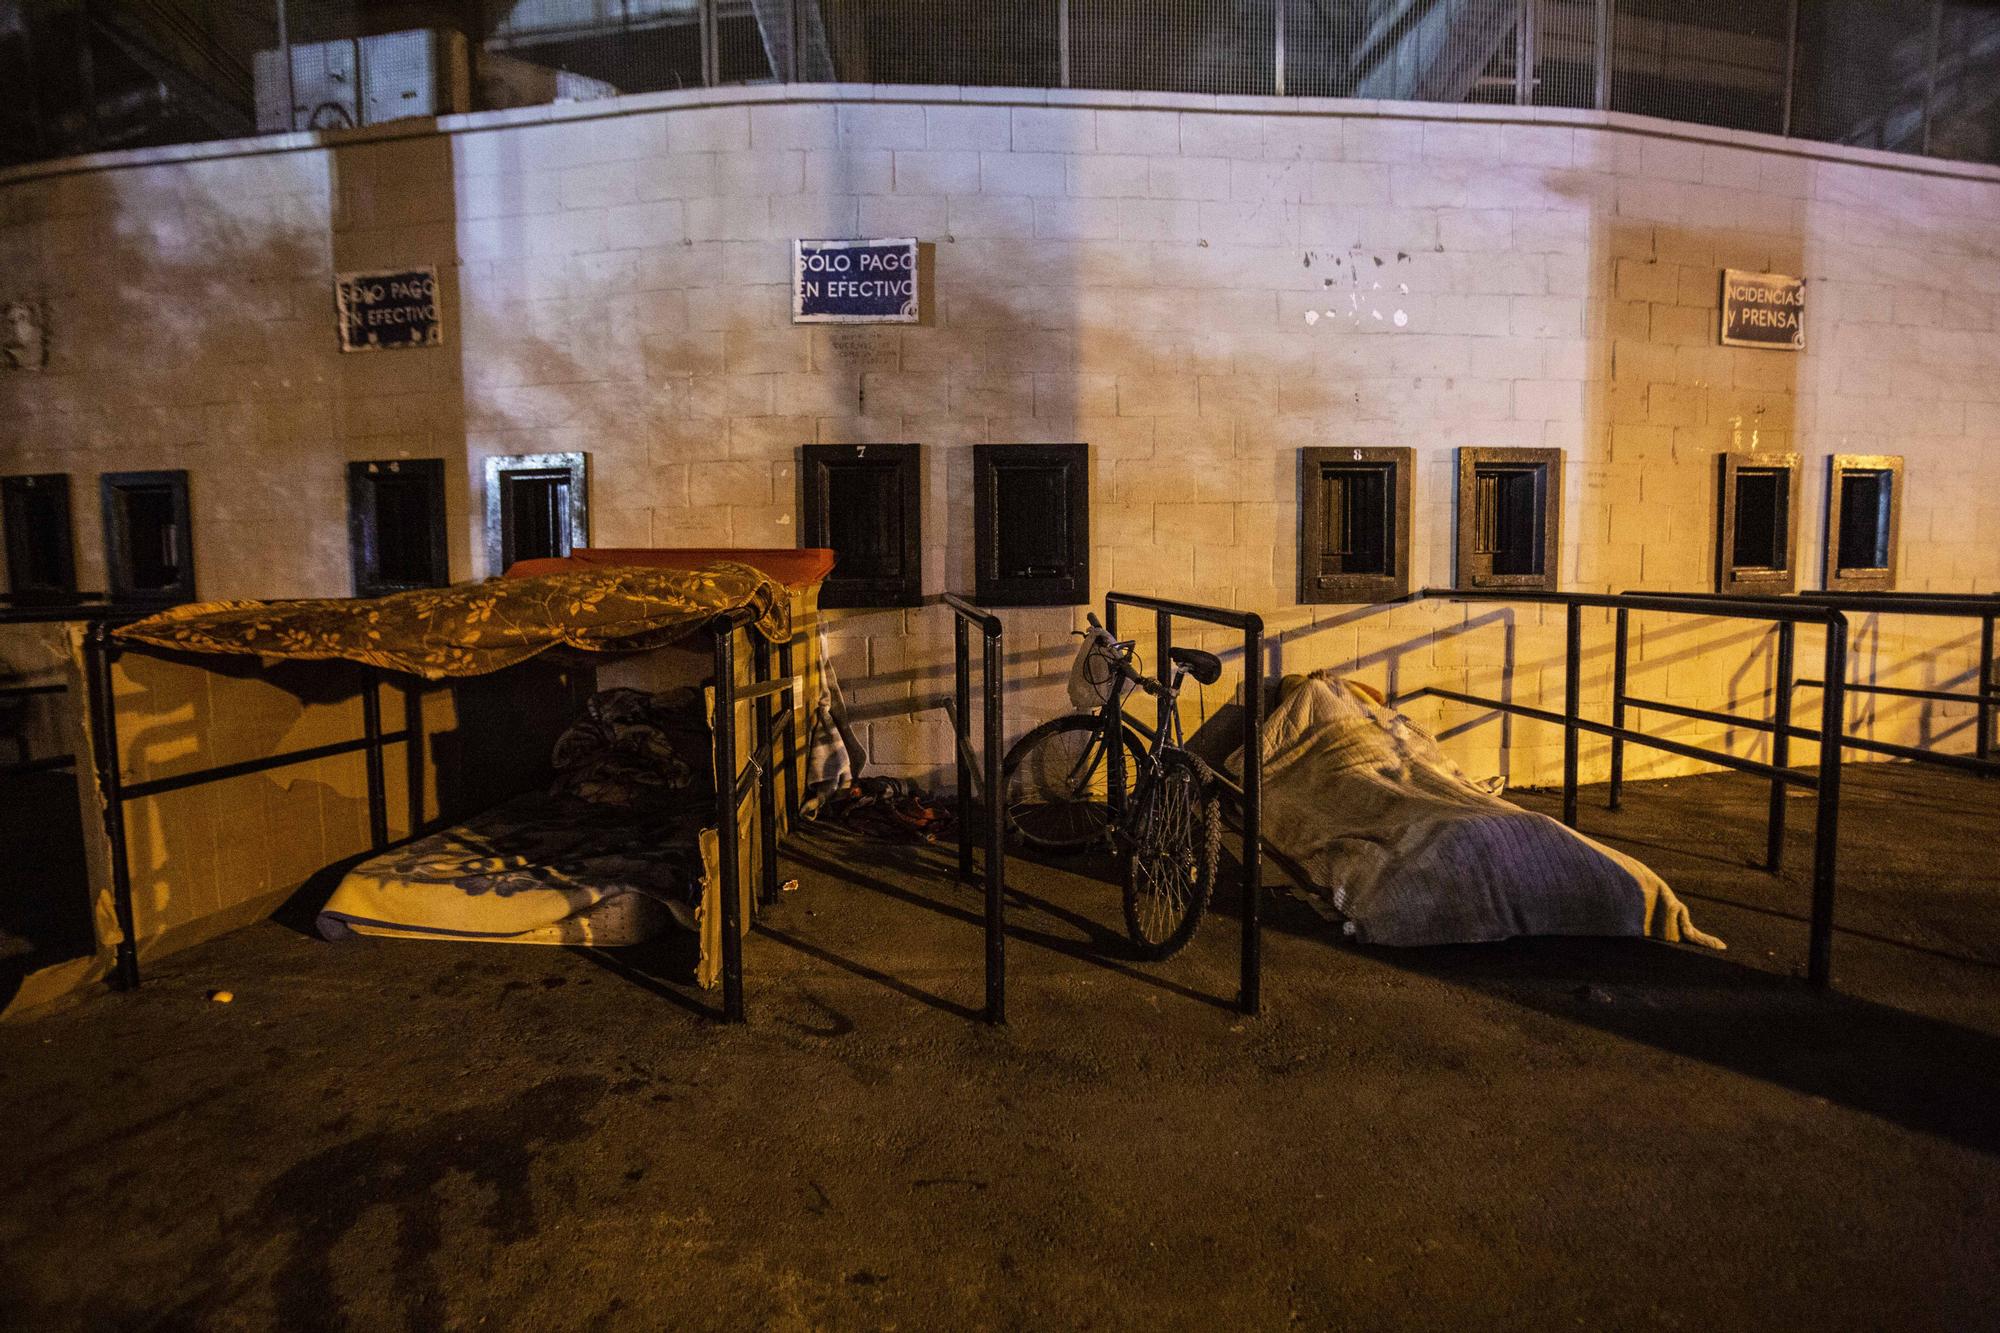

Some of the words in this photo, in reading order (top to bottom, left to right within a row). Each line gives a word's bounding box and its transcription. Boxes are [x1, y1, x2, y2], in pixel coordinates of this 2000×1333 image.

[860, 253, 913, 271] PAGO
[391, 280, 434, 299] PAGO
[828, 280, 913, 298] EFECTIVO
[1728, 286, 1802, 306] NCIDENCIAS
[368, 305, 437, 326] EFECTIVO
[1742, 308, 1798, 329] PRENSA
[856, 445, 866, 458] 7
[1353, 449, 1362, 461] 8
